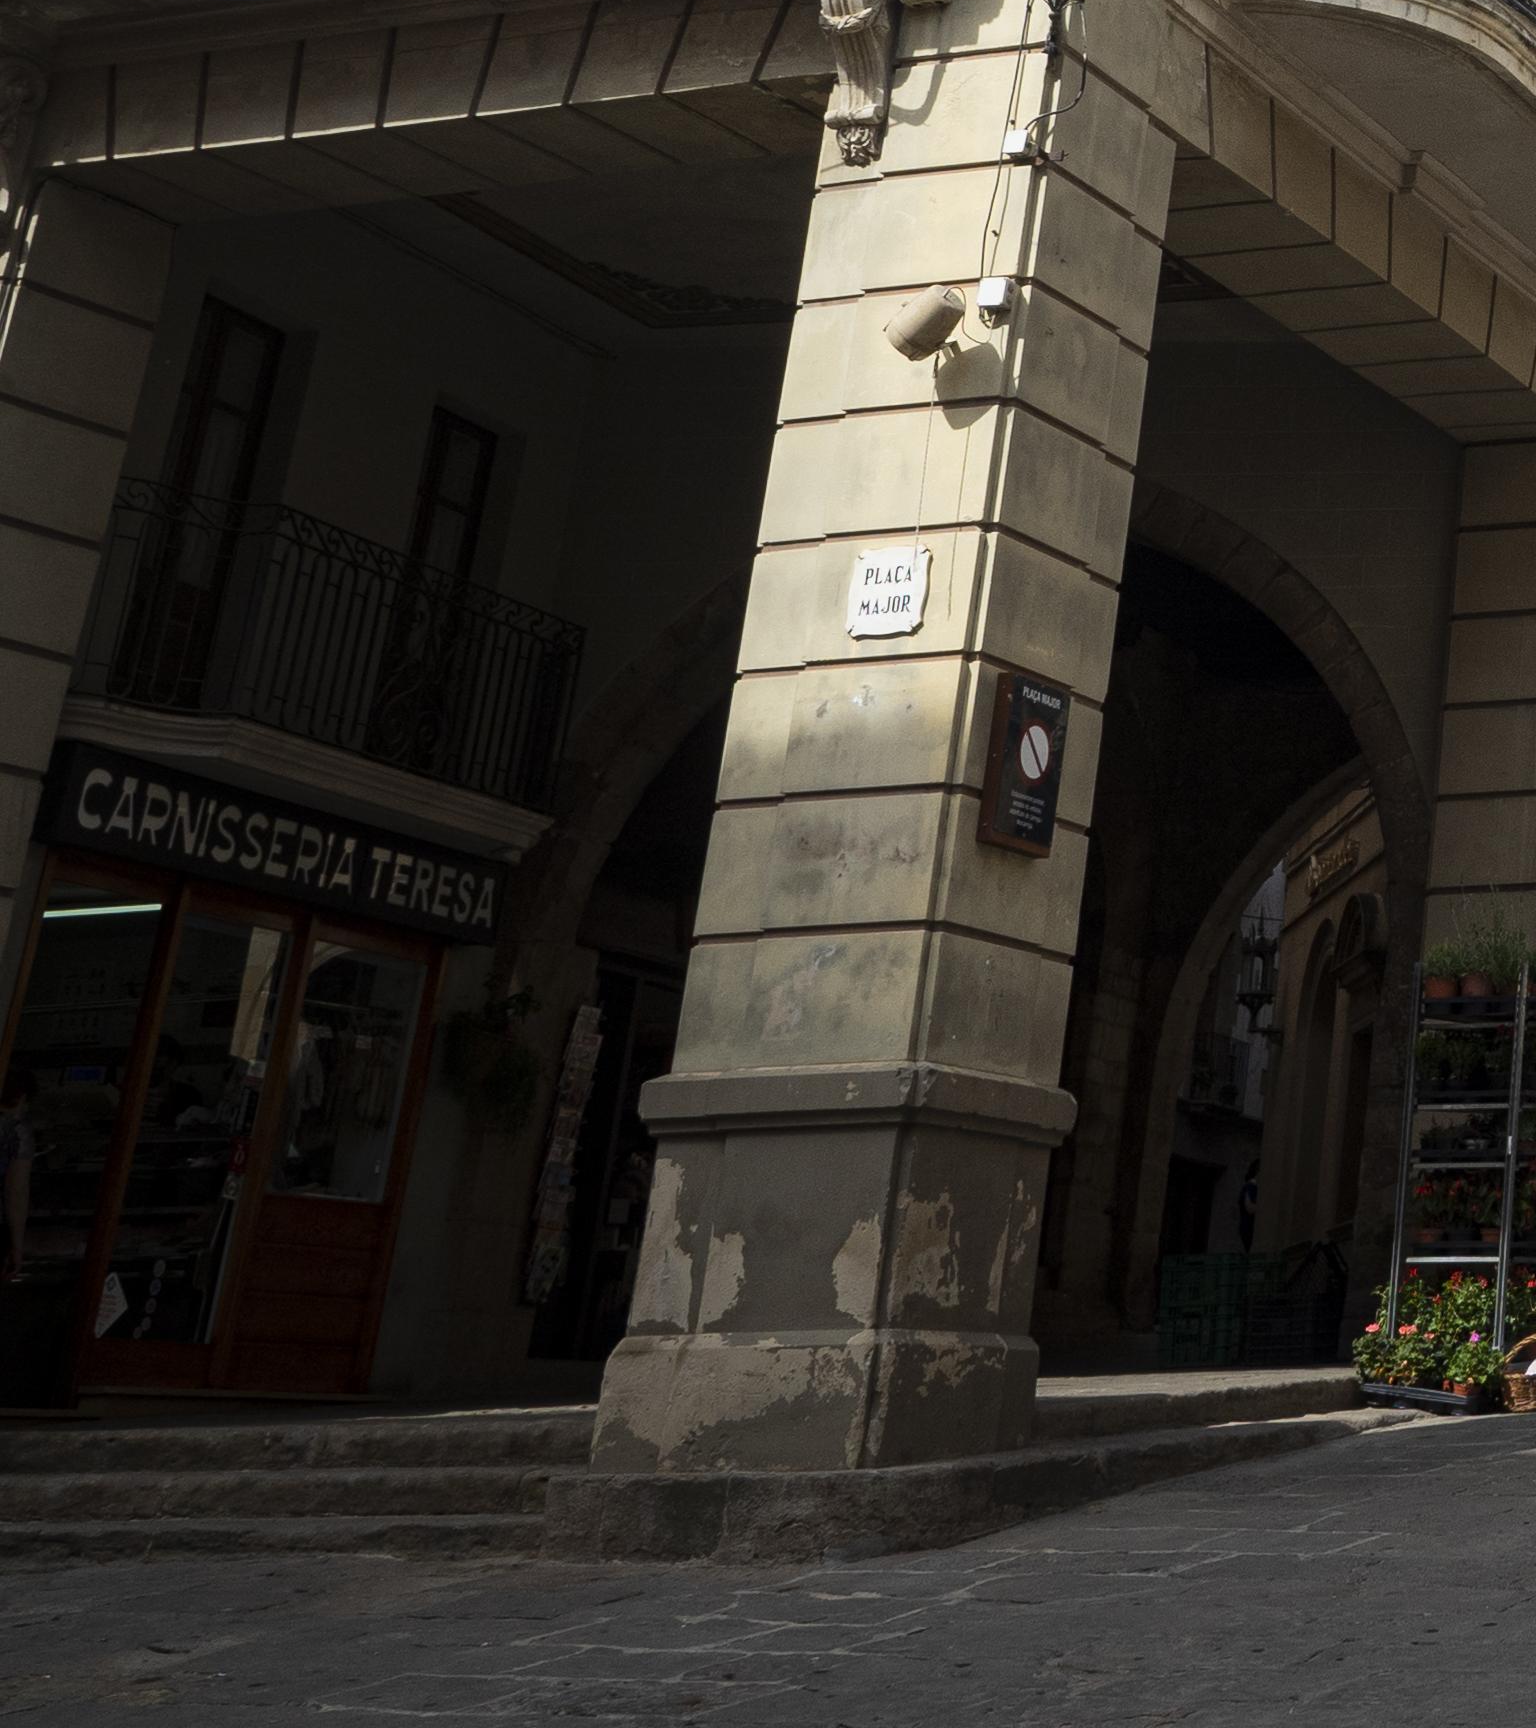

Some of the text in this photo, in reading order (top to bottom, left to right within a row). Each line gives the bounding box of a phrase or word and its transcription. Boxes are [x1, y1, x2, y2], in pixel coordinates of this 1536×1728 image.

[859, 595, 911, 616] MAJOR
[1041, 692, 1061, 710] MAJOR
[77, 767, 497, 929] CARNISSERIA TERESA
